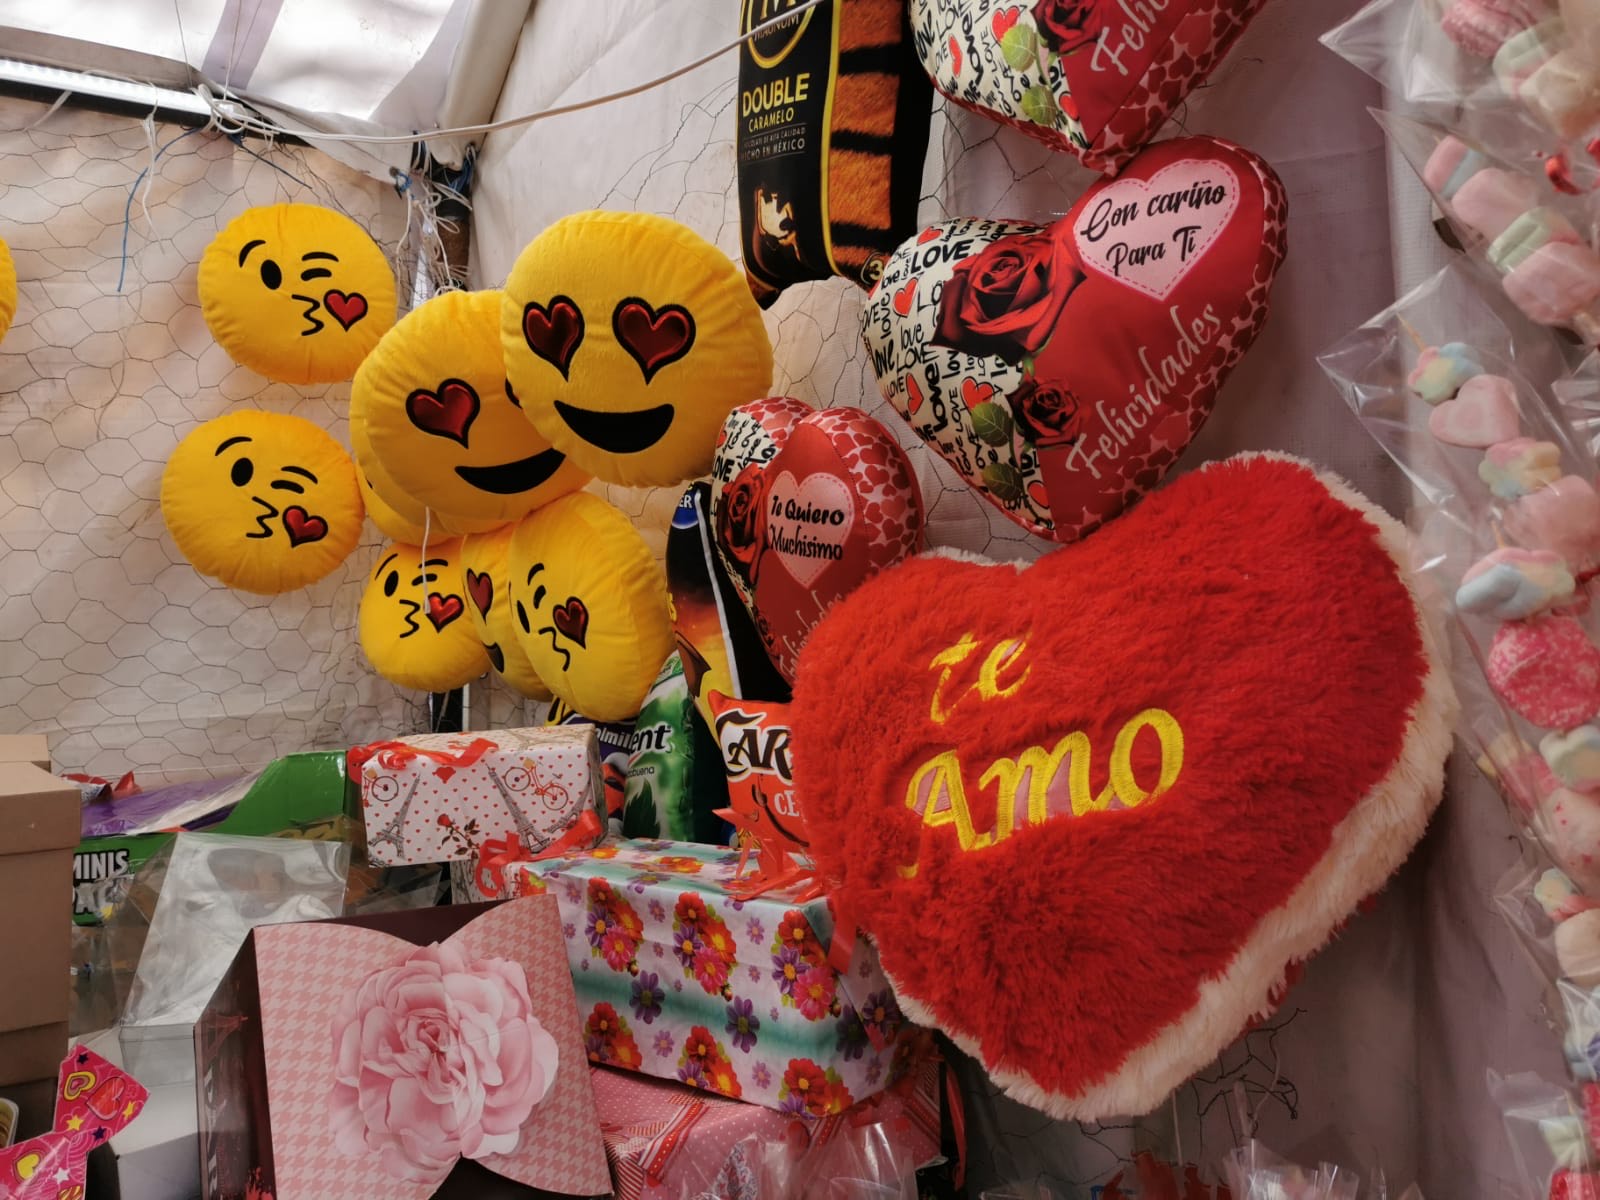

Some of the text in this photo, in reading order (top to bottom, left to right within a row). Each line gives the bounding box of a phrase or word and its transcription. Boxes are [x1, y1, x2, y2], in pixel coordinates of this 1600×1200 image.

[743, 72, 811, 118] DOUBLE
[748, 106, 794, 133] CARAMELO
[1080, 180, 1228, 243] Con cariño
[910, 239, 974, 274] LOVE
[1106, 242, 1167, 277] Para
[1065, 302, 1222, 480] Felicidades
[771, 495, 845, 526] Te Quiero
[769, 523, 843, 561] Muchisimo
[928, 631, 1033, 725] Te
[896, 708, 1184, 879] Amo
